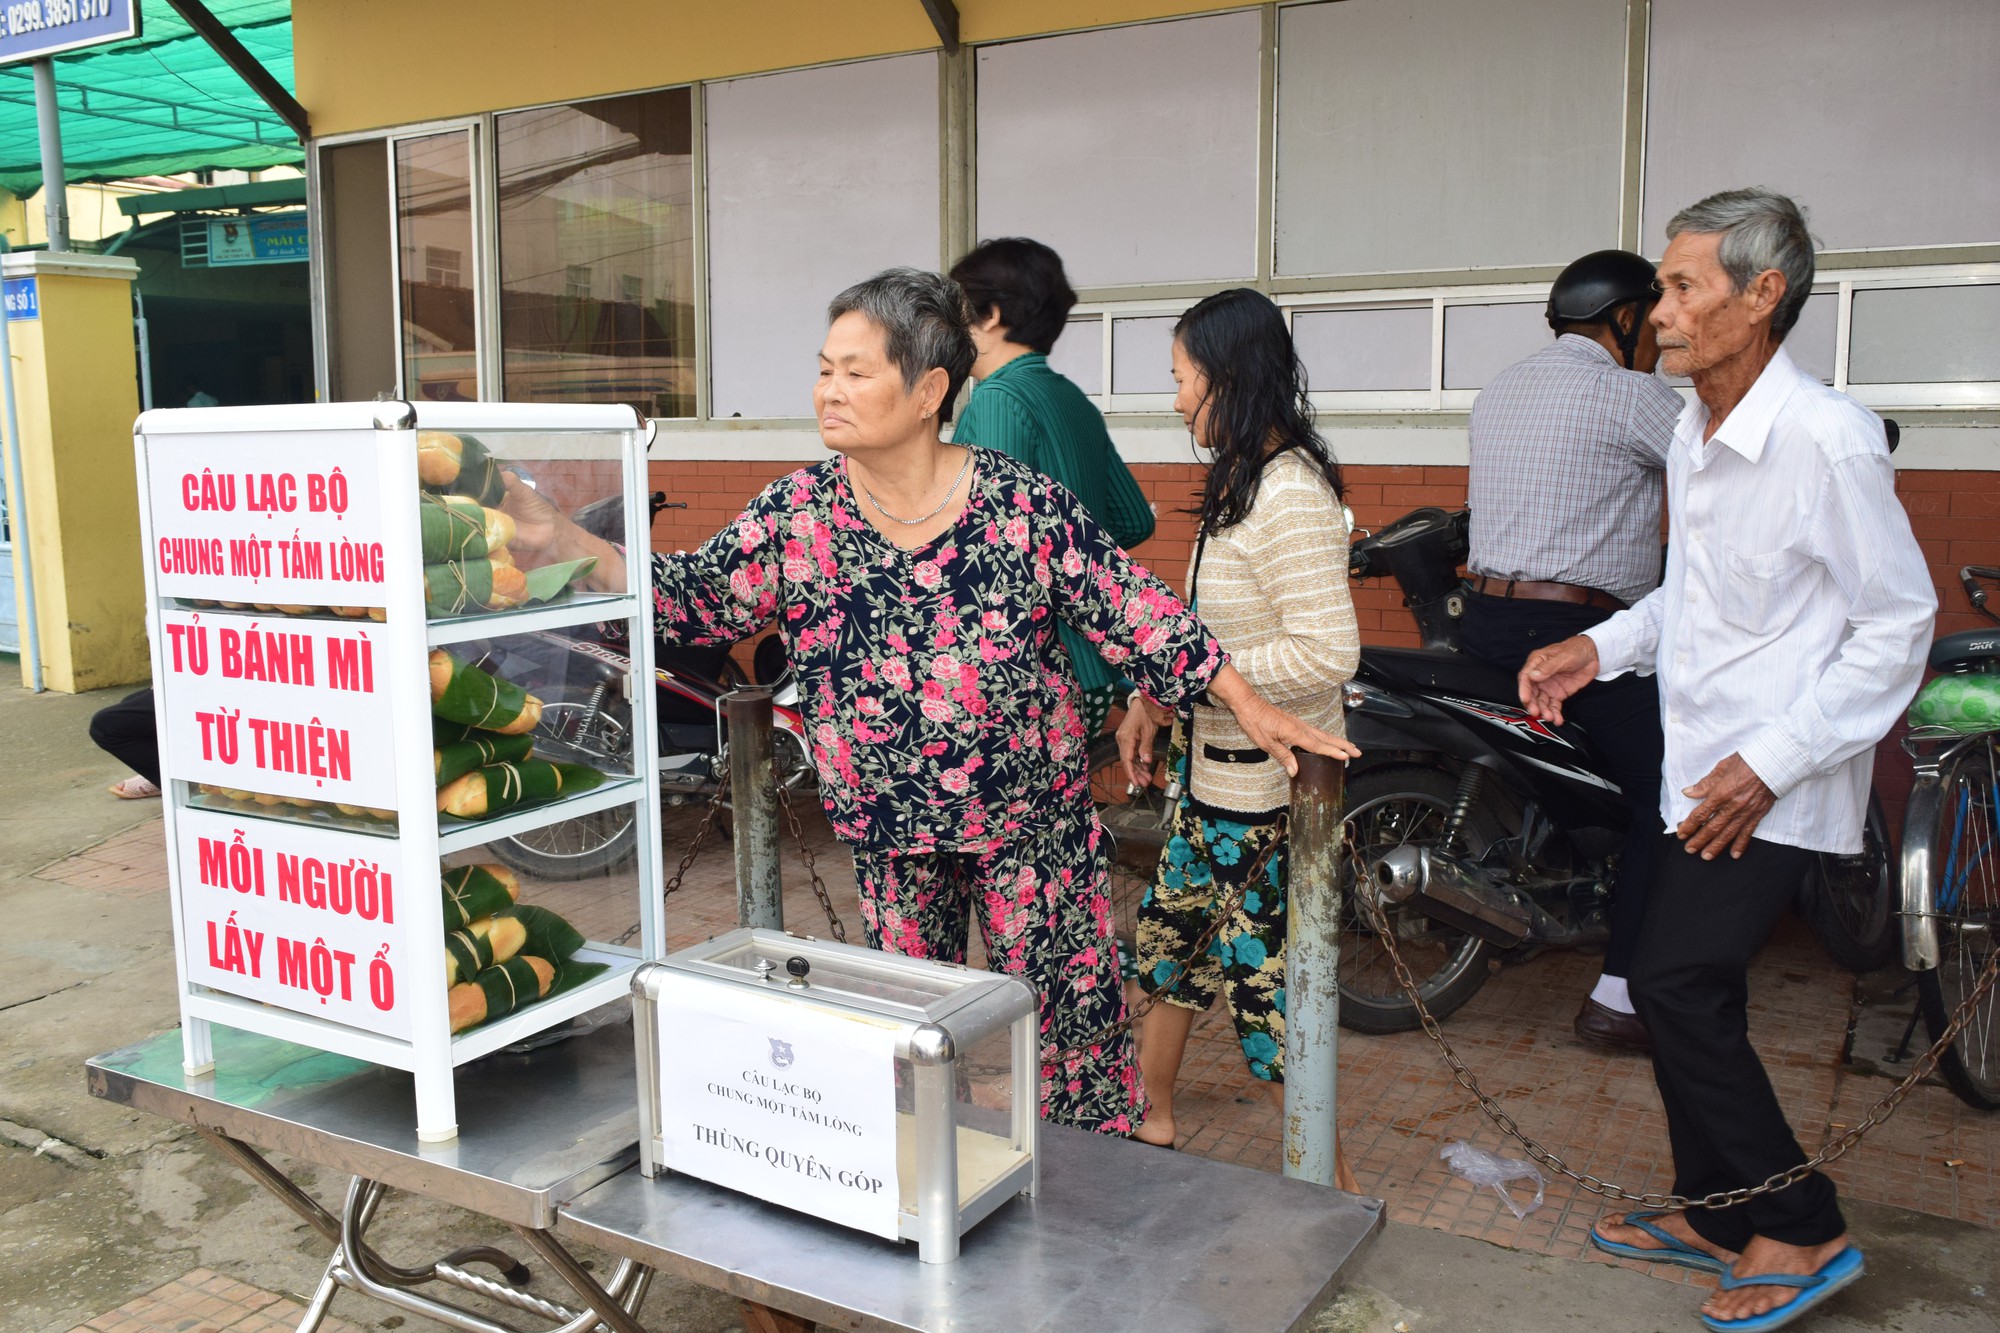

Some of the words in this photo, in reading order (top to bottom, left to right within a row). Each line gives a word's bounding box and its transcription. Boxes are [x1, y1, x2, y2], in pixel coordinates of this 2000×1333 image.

[16, 286, 29, 310] SỐ
[30, 293, 36, 309] 1
[181, 466, 237, 512] CÂU
[244, 472, 298, 520] LẠC
[307, 466, 349, 521] BỘ
[158, 536, 225, 577] CHUNG
[229, 532, 273, 585] MỘT
[277, 527, 324, 581] TẤM
[329, 535, 385, 584] LÒNG
[165, 612, 209, 677] TỦ
[218, 621, 315, 687] BÁNH
[326, 630, 375, 694] MÌ
[194, 705, 241, 766] TỪ
[247, 716, 352, 788] THIỆN
[197, 828, 266, 897] MỖI
[276, 851, 395, 925] NGƯỜI
[206, 909, 265, 979] LẤY
[276, 936, 356, 1005] MỘT
[368, 942, 395, 1012] Ổ
[707, 1082, 753, 1105] CHUNG
[824, 1115, 862, 1137] LÒNG
[742, 1069, 769, 1088] CÂU
[773, 1078, 800, 1096] LẠC
[692, 1123, 760, 1158] THÙNG
[765, 1146, 832, 1182] QUYÊN
[838, 1170, 883, 1195] GÓP
